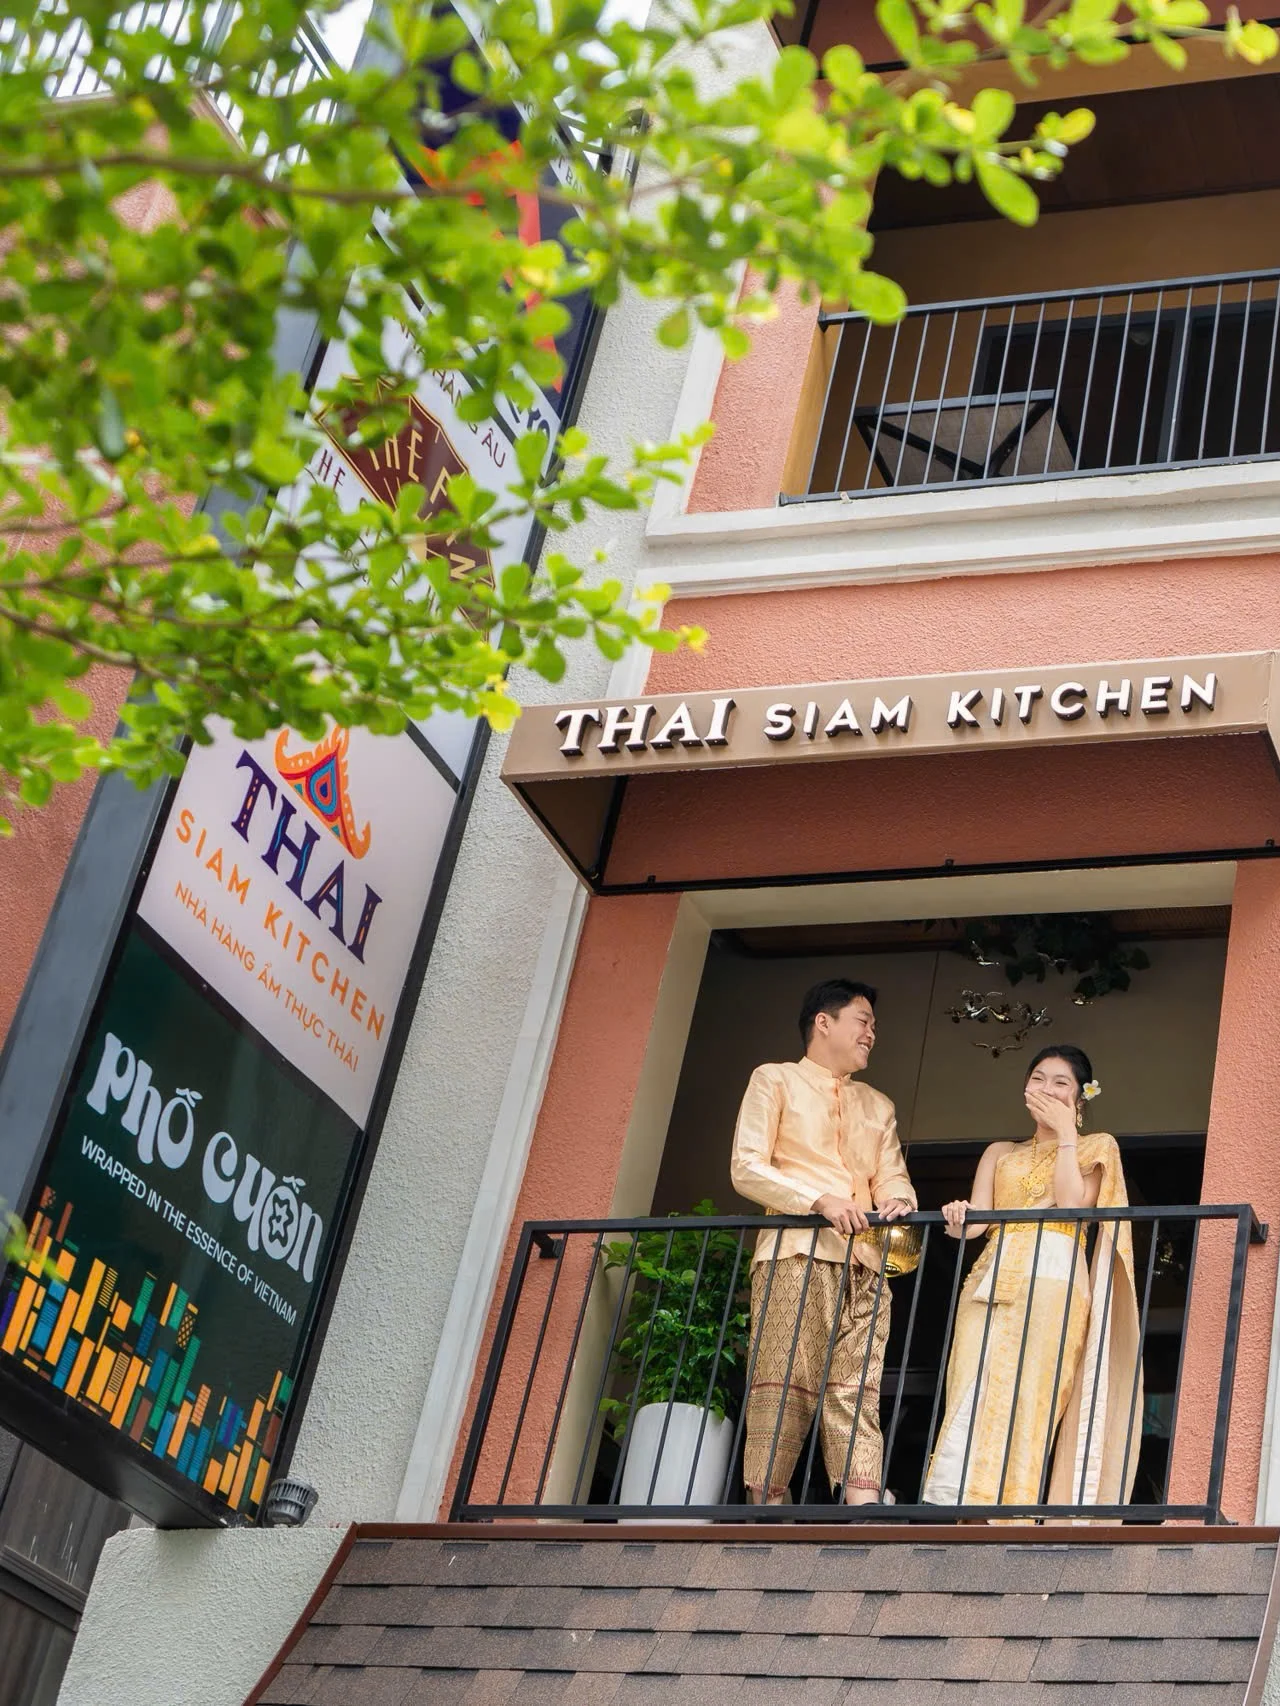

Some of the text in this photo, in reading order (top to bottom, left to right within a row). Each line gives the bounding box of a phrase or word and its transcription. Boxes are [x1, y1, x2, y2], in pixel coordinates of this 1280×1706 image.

[555, 673, 1218, 757] THAI SIAM KITCHEN
[176, 808, 386, 1041] SIAM KITCHEN
[231, 749, 383, 965] THAI
[175, 881, 208, 928] NHÀ
[211, 917, 256, 972] HÀNG
[284, 988, 325, 1038] THỰC
[326, 1029, 359, 1073] THÁI
[81, 1135, 298, 1327] WRAPPED IN THE ESSENCE OF VIETNAM
